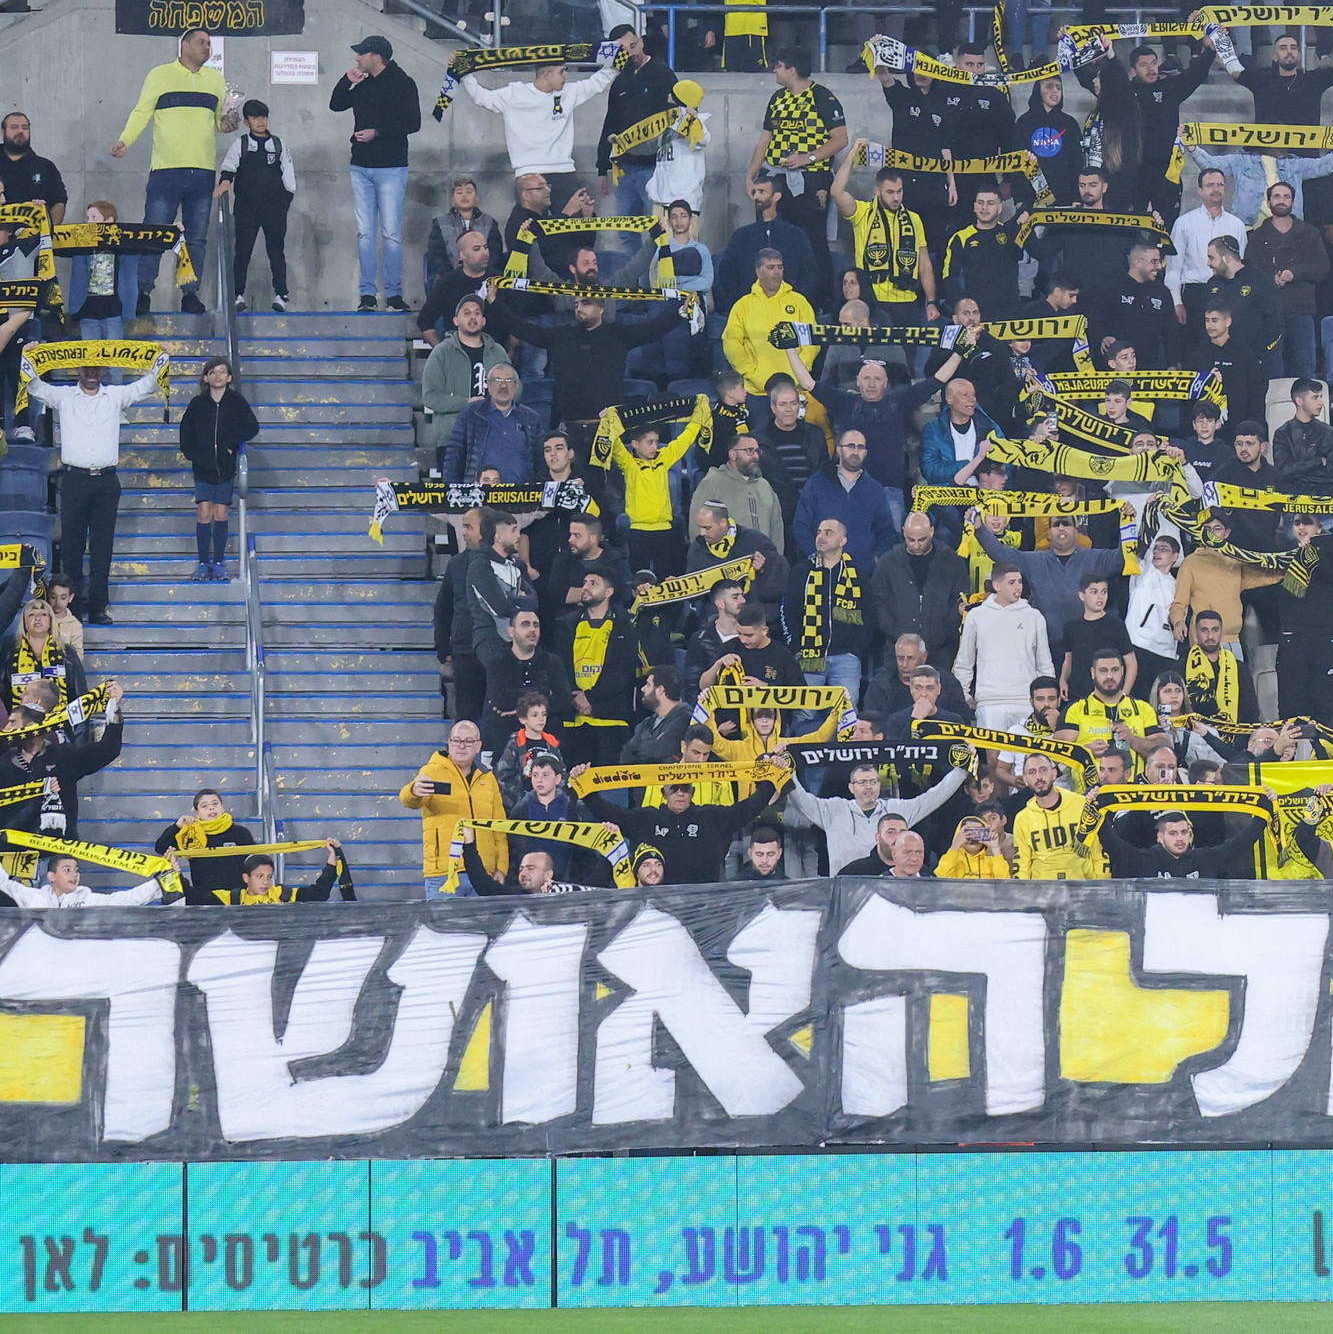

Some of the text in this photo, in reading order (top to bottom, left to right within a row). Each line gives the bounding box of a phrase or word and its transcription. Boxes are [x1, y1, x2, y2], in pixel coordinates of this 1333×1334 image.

[149, 0, 265, 29] המשפחה
[1213, 7, 1301, 23] ירושלים
[1209, 126, 1316, 143] ירושלים
[2, 283, 39, 298] בית"ר
[397, 489, 542, 504] ירושלים JERUSALEM
[836, 597, 857, 610] FCBJ
[725, 688, 833, 706] ירושלים
[938, 722, 1075, 757] בית"ר ירושלים
[802, 745, 938, 764] בית"ר ירושלים
[593, 771, 641, 784] diadora
[1115, 790, 1261, 803] בית"ר ירושלים
[0, 890, 1048, 1142] האושר
[21, 1218, 1233, 1302] 31.5 1.6 גני יהושע, תל אביב כרטיסים: לאן
